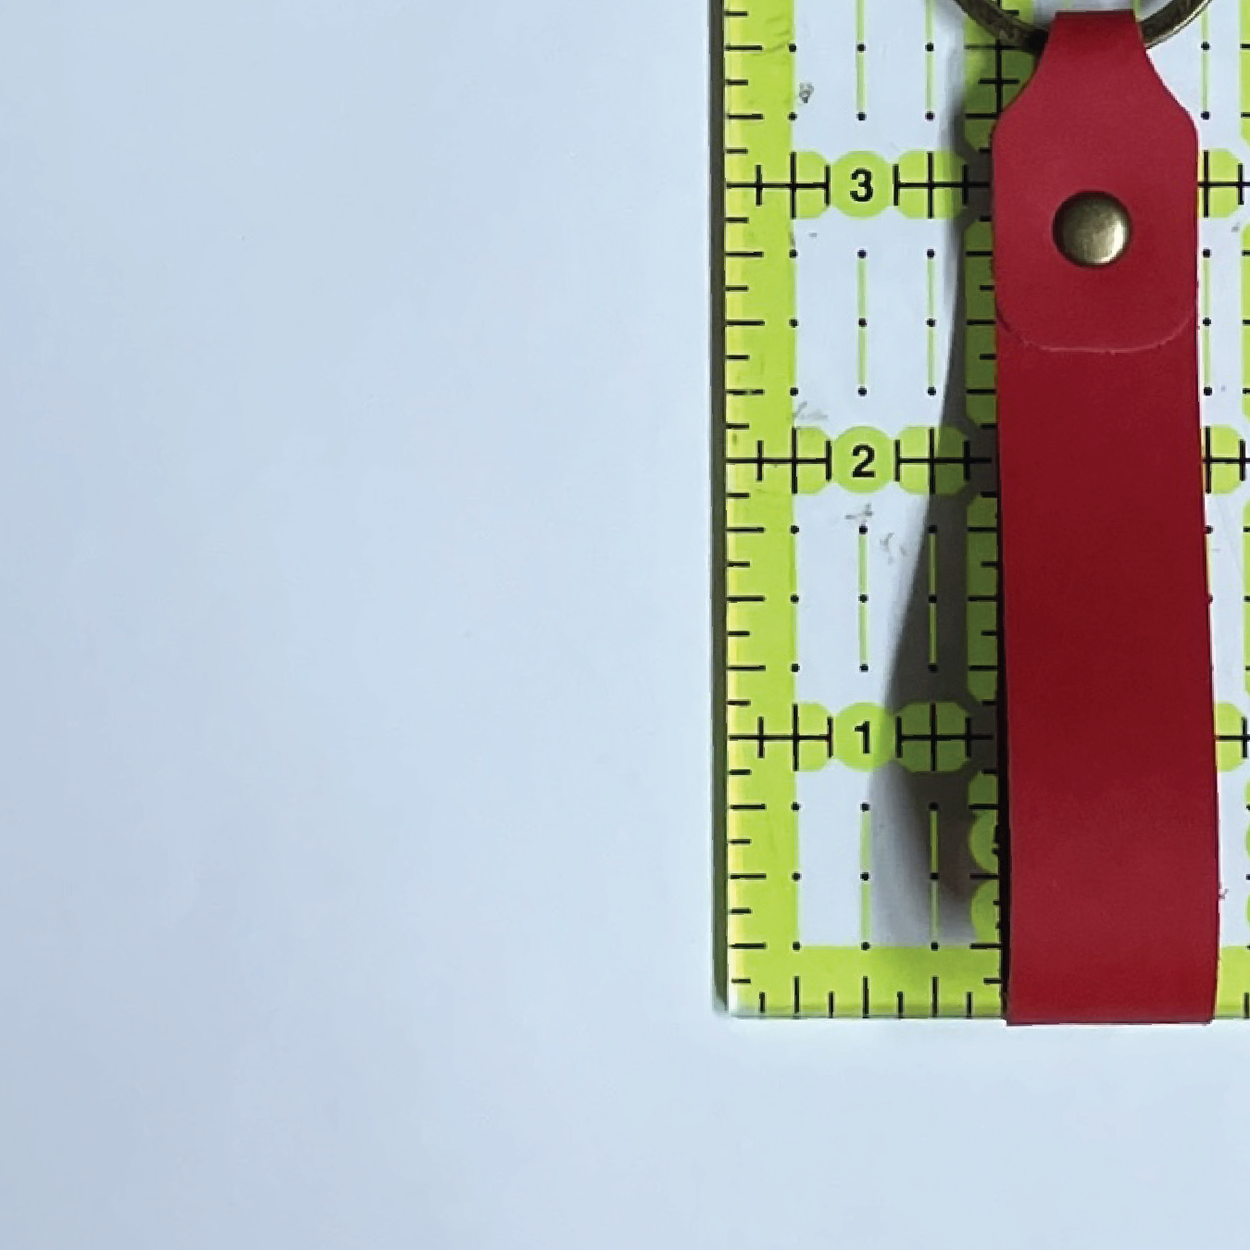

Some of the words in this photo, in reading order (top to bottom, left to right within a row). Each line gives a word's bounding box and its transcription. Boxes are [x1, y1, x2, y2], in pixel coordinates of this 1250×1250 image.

[849, 168, 874, 203] 3
[852, 444, 875, 478] 2
[854, 720, 871, 754] 1
